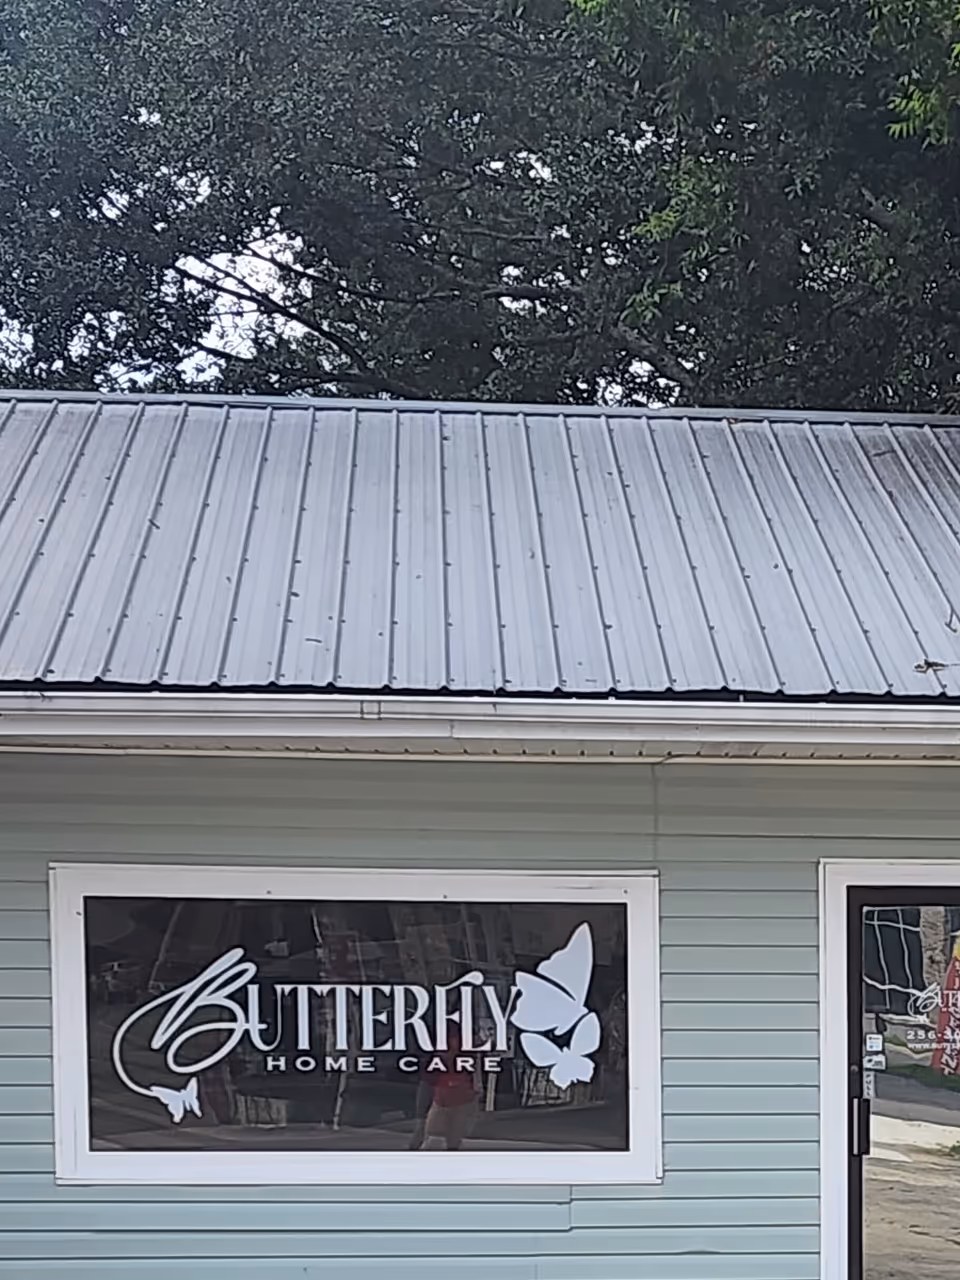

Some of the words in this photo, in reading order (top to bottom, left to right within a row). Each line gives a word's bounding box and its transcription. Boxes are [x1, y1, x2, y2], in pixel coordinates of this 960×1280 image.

[113, 947, 517, 1097] BUTTERFLY
[266, 1056, 375, 1072] HOME
[400, 1056, 502, 1072] CARE
